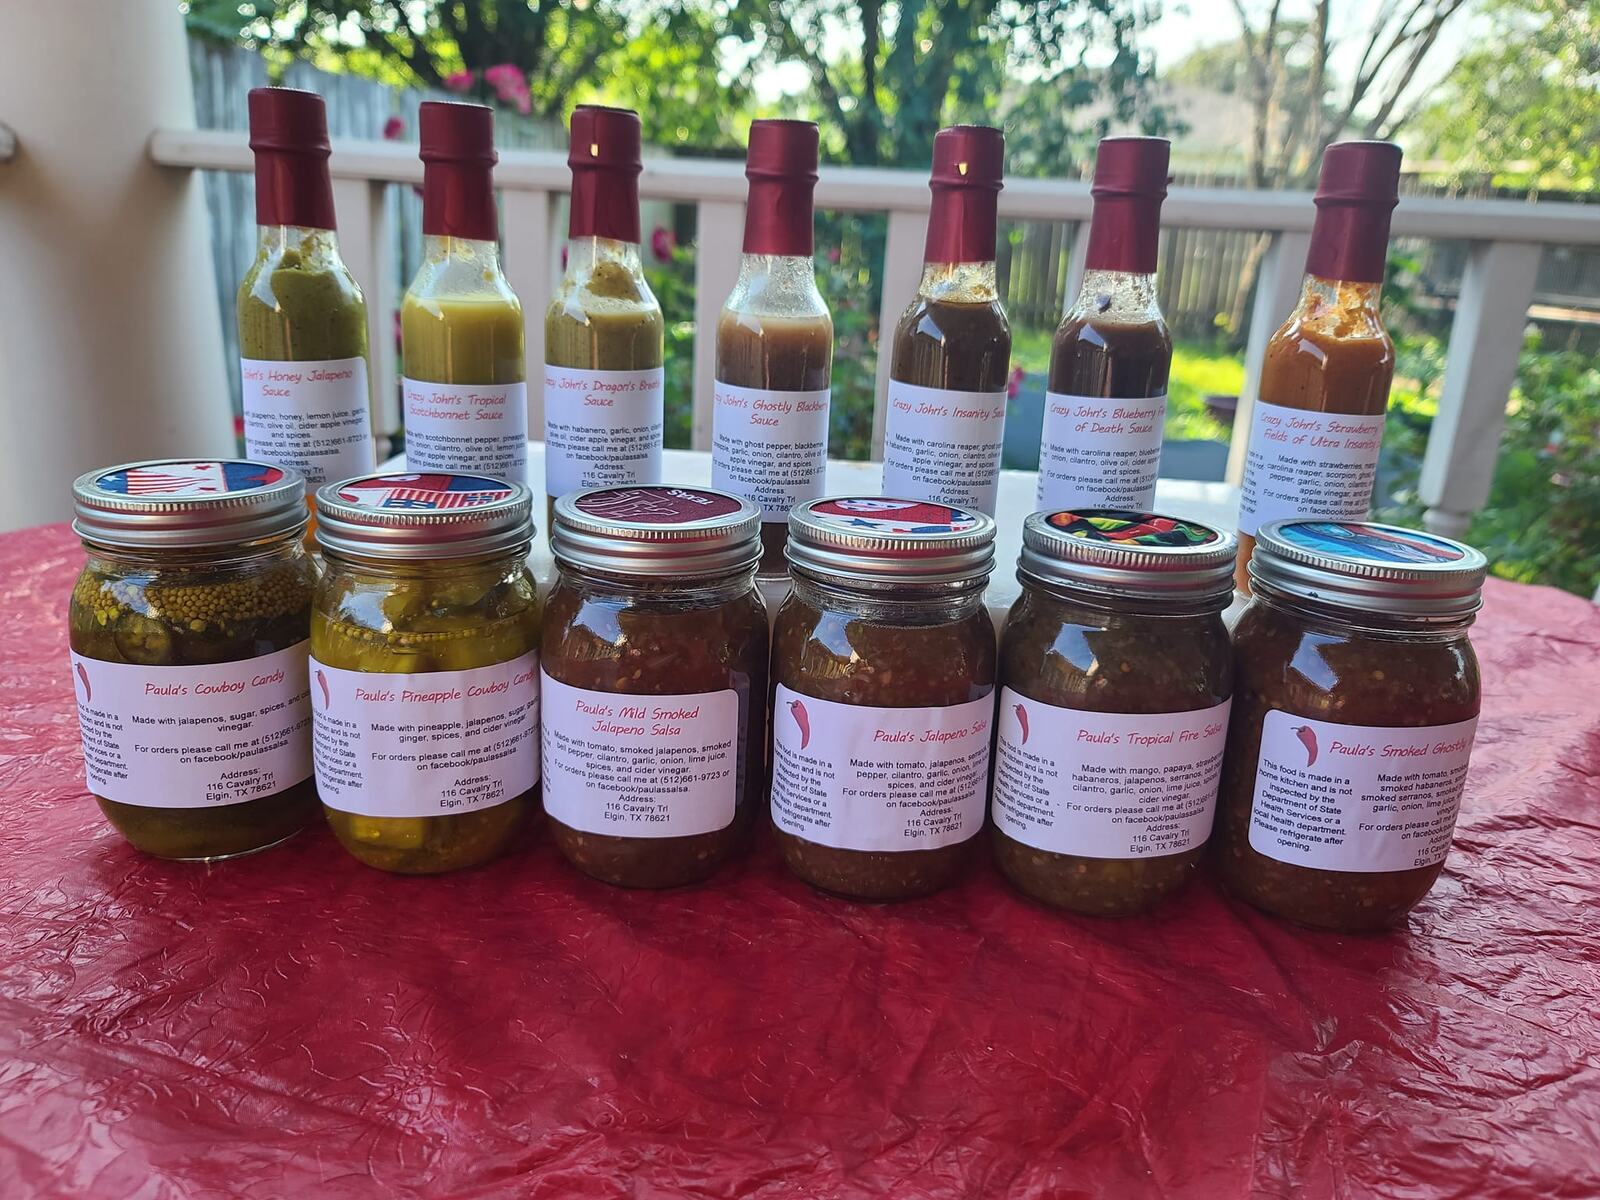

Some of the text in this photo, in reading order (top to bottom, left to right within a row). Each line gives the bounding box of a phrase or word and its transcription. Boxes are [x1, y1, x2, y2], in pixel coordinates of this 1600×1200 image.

[269, 370, 302, 384] Honey
[307, 369, 352, 382] Jalapeno
[262, 384, 290, 397] Sauce
[593, 380, 635, 394] Dragon's
[429, 393, 462, 405] John's
[468, 394, 506, 407] Tropical
[584, 394, 614, 406] Sauce
[753, 400, 792, 414] Ghostly
[475, 409, 504, 420] Sauce
[915, 403, 948, 416] John's
[952, 407, 990, 420] Insanity
[1073, 406, 1108, 418] John's
[1112, 408, 1156, 420] Blueberry
[750, 414, 780, 426] Sauce
[1286, 417, 1321, 431] John's
[1075, 422, 1152, 434] of Death Sauce
[1292, 434, 1308, 444] of
[1310, 436, 1340, 448] Ultra
[145, 669, 284, 696] Paula's Cowboy Candy
[356, 681, 509, 704] Paula's Pineapple Cowboy
[132, 702, 286, 726] Made with jalapenos, sugar, spices,
[576, 700, 700, 720] Paula's Mild Smoked
[217, 720, 254, 732] vinegar.
[371, 712, 507, 733] Made with pineapple, jalapenos,
[592, 720, 681, 736] Jalapeno Salsa
[398, 724, 502, 744] ginger, spices, and cider
[873, 728, 968, 744] Paula's Jalapeno
[1077, 730, 1120, 744] Paula's
[1127, 732, 1174, 748] Tropical
[1178, 730, 1199, 742] Fire
[554, 730, 732, 756] Made with tomato, smoked jalapenos, smoked
[1329, 741, 1376, 756] Paula's
[1380, 744, 1429, 757] Smoked
[568, 747, 728, 766] pepper, cilantro, garlic, onion, lime juice,
[850, 758, 874, 768] Made
[876, 761, 894, 769] with
[585, 761, 692, 776] spices, and cider vinegar.
[856, 768, 950, 780] pepper, cilantro, garlic,
[1081, 764, 1106, 774] Made
[1129, 767, 1160, 776] mango,
[1164, 764, 1194, 774] papaya,
[1264, 758, 1278, 770] This
[1280, 765, 1296, 776] food
[1308, 773, 1332, 783] made
[207, 782, 224, 790] 116
[226, 775, 261, 789] Cavalry
[586, 780, 596, 788] on
[1072, 773, 1168, 786] habaneros, jalapenos,
[1280, 776, 1308, 789] kitchen
[1310, 784, 1327, 792] and
[1378, 772, 1420, 782] Made with
[619, 794, 656, 803] Address:
[1270, 782, 1336, 804] inspected by the
[622, 804, 655, 813] Cavalry
[1262, 790, 1307, 810] Department
[1320, 805, 1342, 815] State
[604, 811, 627, 822] Elgin,
[644, 814, 670, 822] 78621
[1260, 800, 1284, 814] Health
[1286, 809, 1322, 822] Services
[1270, 814, 1294, 827] health
[1359, 821, 1430, 832] For orders please
[1254, 817, 1344, 846] Please refrigerate after
[1277, 838, 1312, 852] opening.
